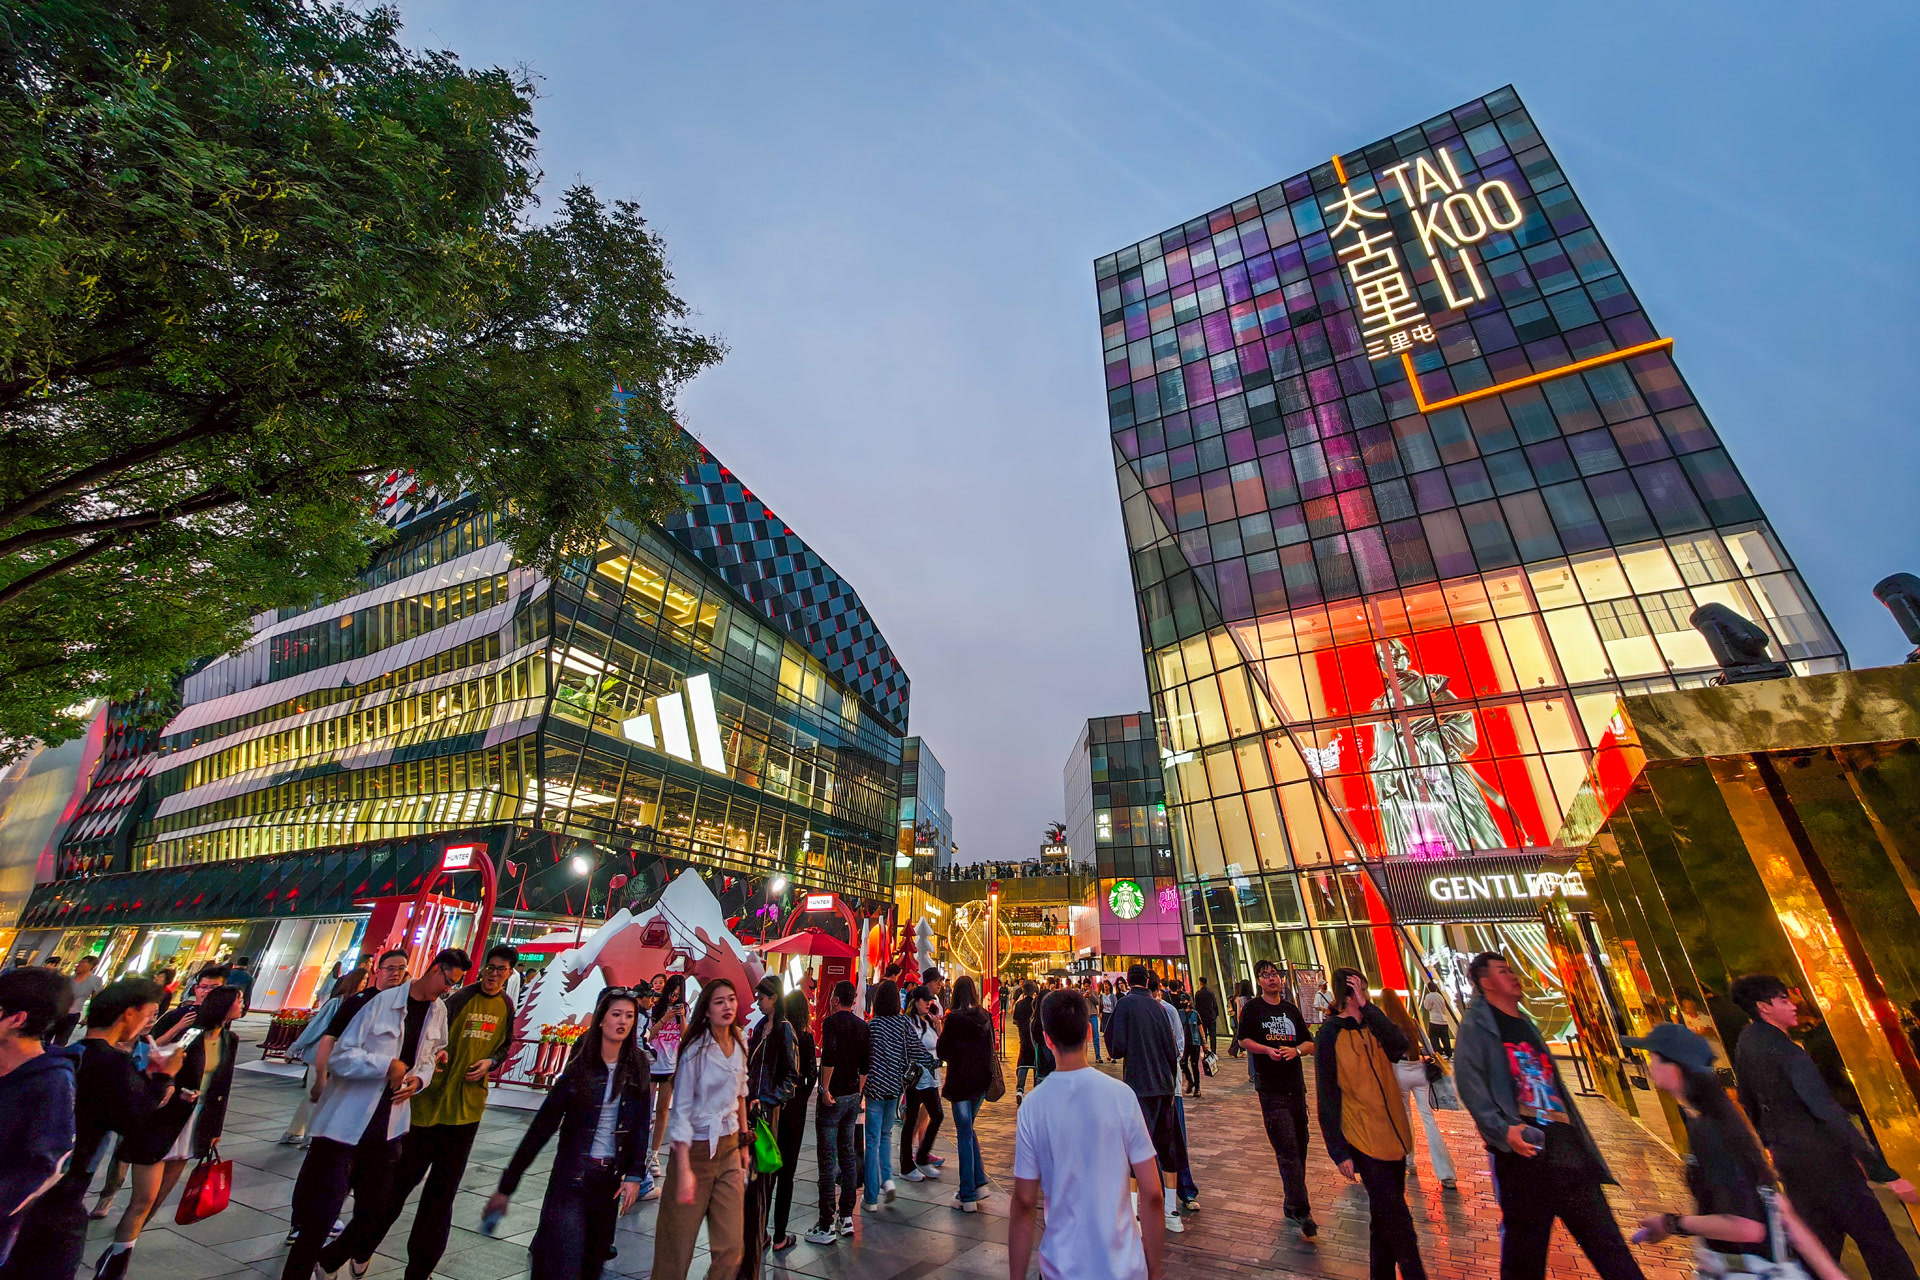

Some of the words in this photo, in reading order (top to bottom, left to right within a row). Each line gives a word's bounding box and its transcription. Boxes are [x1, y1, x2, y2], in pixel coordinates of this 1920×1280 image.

[1383, 147, 1464, 208] TAI
[1410, 179, 1523, 257] KOO
[1324, 185, 1426, 337] 太古里
[1431, 248, 1486, 310] LI
[1365, 324, 1436, 361] 三里屯
[447, 852, 470, 861] HUNTER
[1045, 846, 1062, 855] CASA
